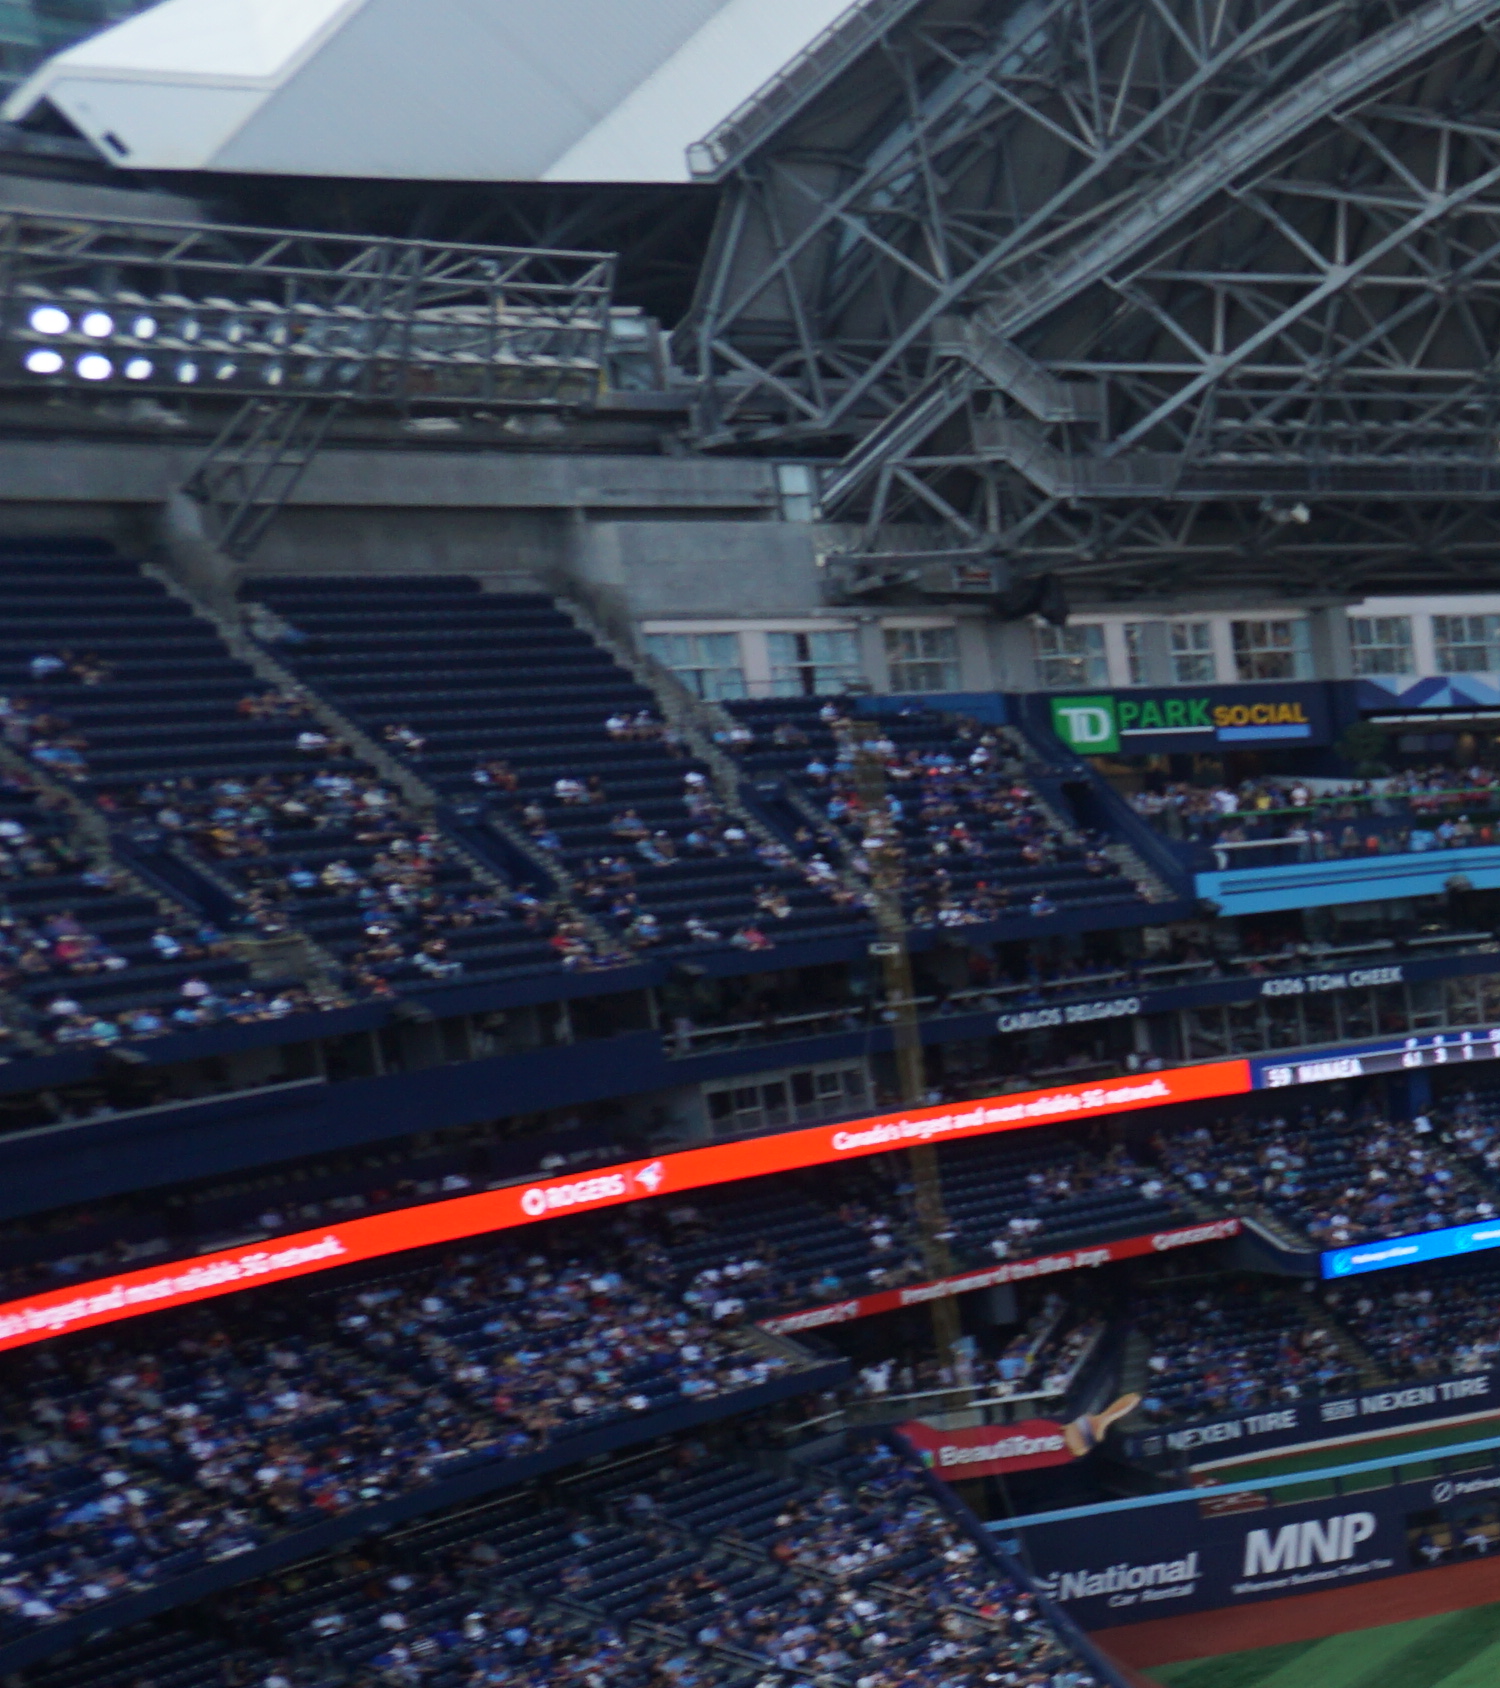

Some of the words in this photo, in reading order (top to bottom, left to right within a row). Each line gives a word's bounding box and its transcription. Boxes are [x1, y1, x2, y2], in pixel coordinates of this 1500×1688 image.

[1058, 707, 1110, 743] TD
[1119, 699, 1211, 728] PARK
[1213, 703, 1309, 727] SOCIAL
[1262, 976, 1304, 996] 4306
[1306, 973, 1346, 993] TOM
[1349, 966, 1402, 987] CHEEK
[997, 1006, 1064, 1033] CARLOS
[1065, 997, 1141, 1024] DELGADO
[545, 1173, 625, 1211] ROGERS
[1361, 1386, 1437, 1414] NEXEN
[1439, 1376, 1490, 1399] TIRE
[939, 1432, 1063, 1467] BeautiTone
[1167, 1421, 1242, 1452] NEXEN
[1245, 1409, 1298, 1435] TIRE
[1244, 1511, 1376, 1577] MNP
[1060, 1551, 1203, 1600] National
